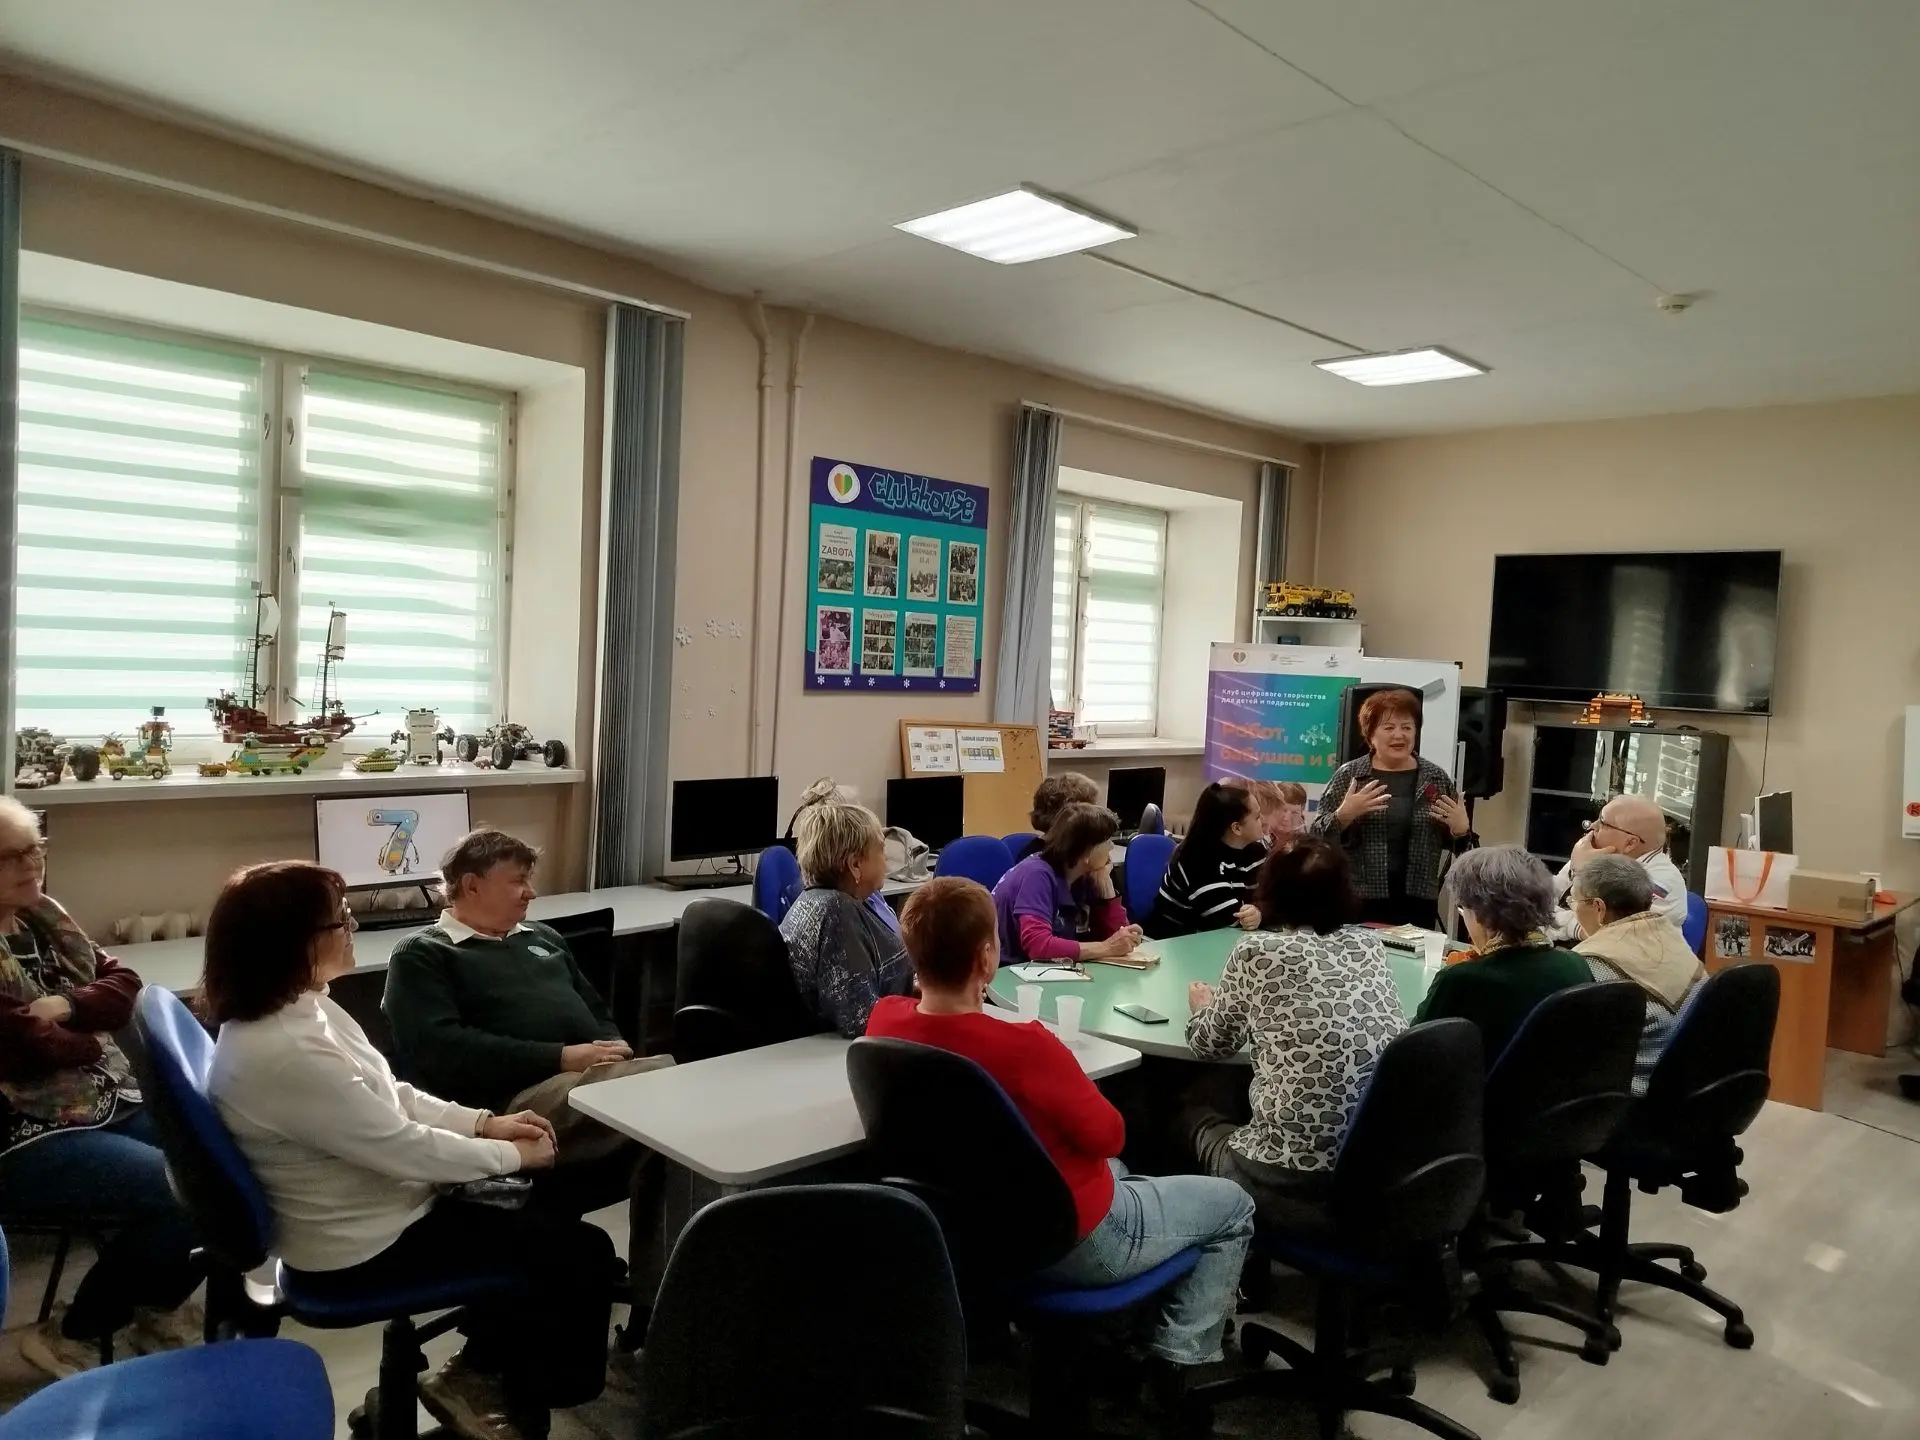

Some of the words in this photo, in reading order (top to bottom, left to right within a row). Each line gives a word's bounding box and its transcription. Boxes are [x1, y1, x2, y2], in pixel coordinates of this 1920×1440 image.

[1222, 688, 1239, 697] Клуб
[1241, 690, 1282, 699] цифрового
[1283, 692, 1327, 700] творчества
[1266, 700, 1310, 708] подростков
